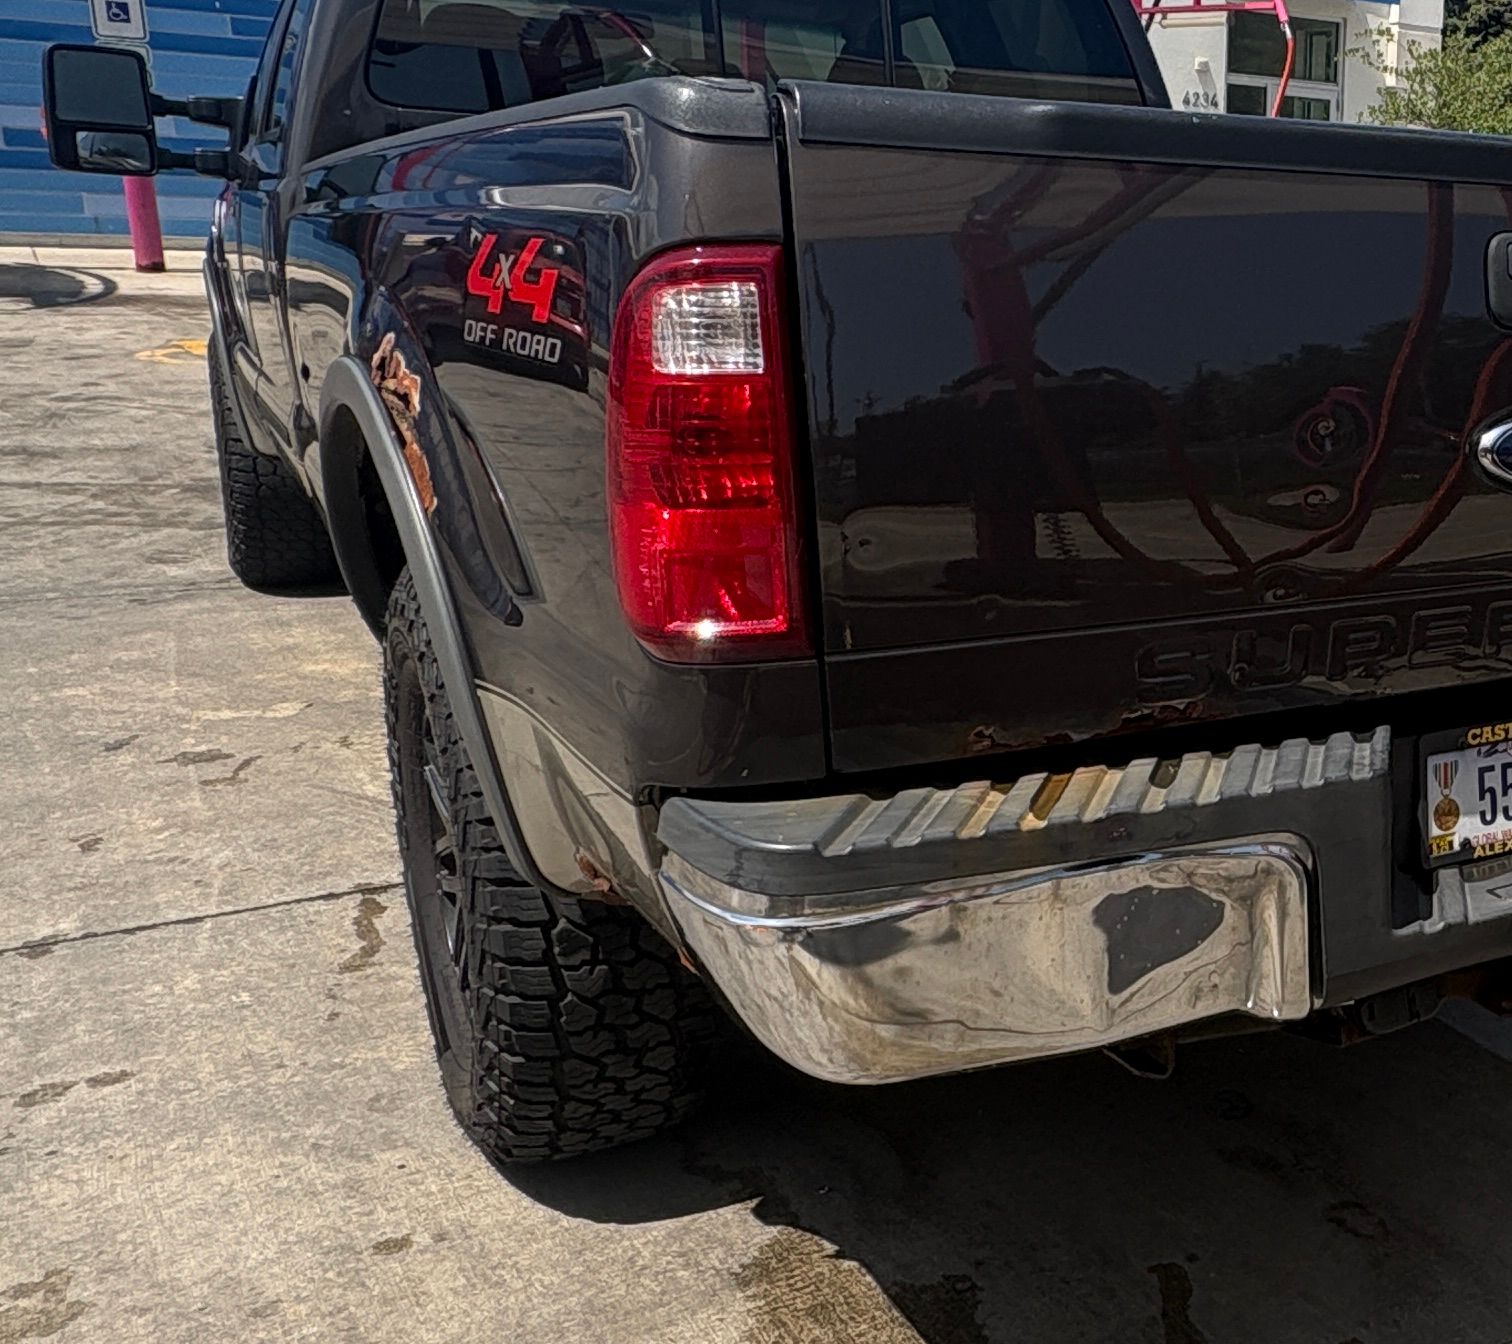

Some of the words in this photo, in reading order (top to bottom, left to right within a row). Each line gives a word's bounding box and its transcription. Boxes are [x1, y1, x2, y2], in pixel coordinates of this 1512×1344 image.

[463, 319, 498, 346] OFF
[502, 327, 562, 363] ROAD
[1472, 833, 1499, 847] GLOBAL
